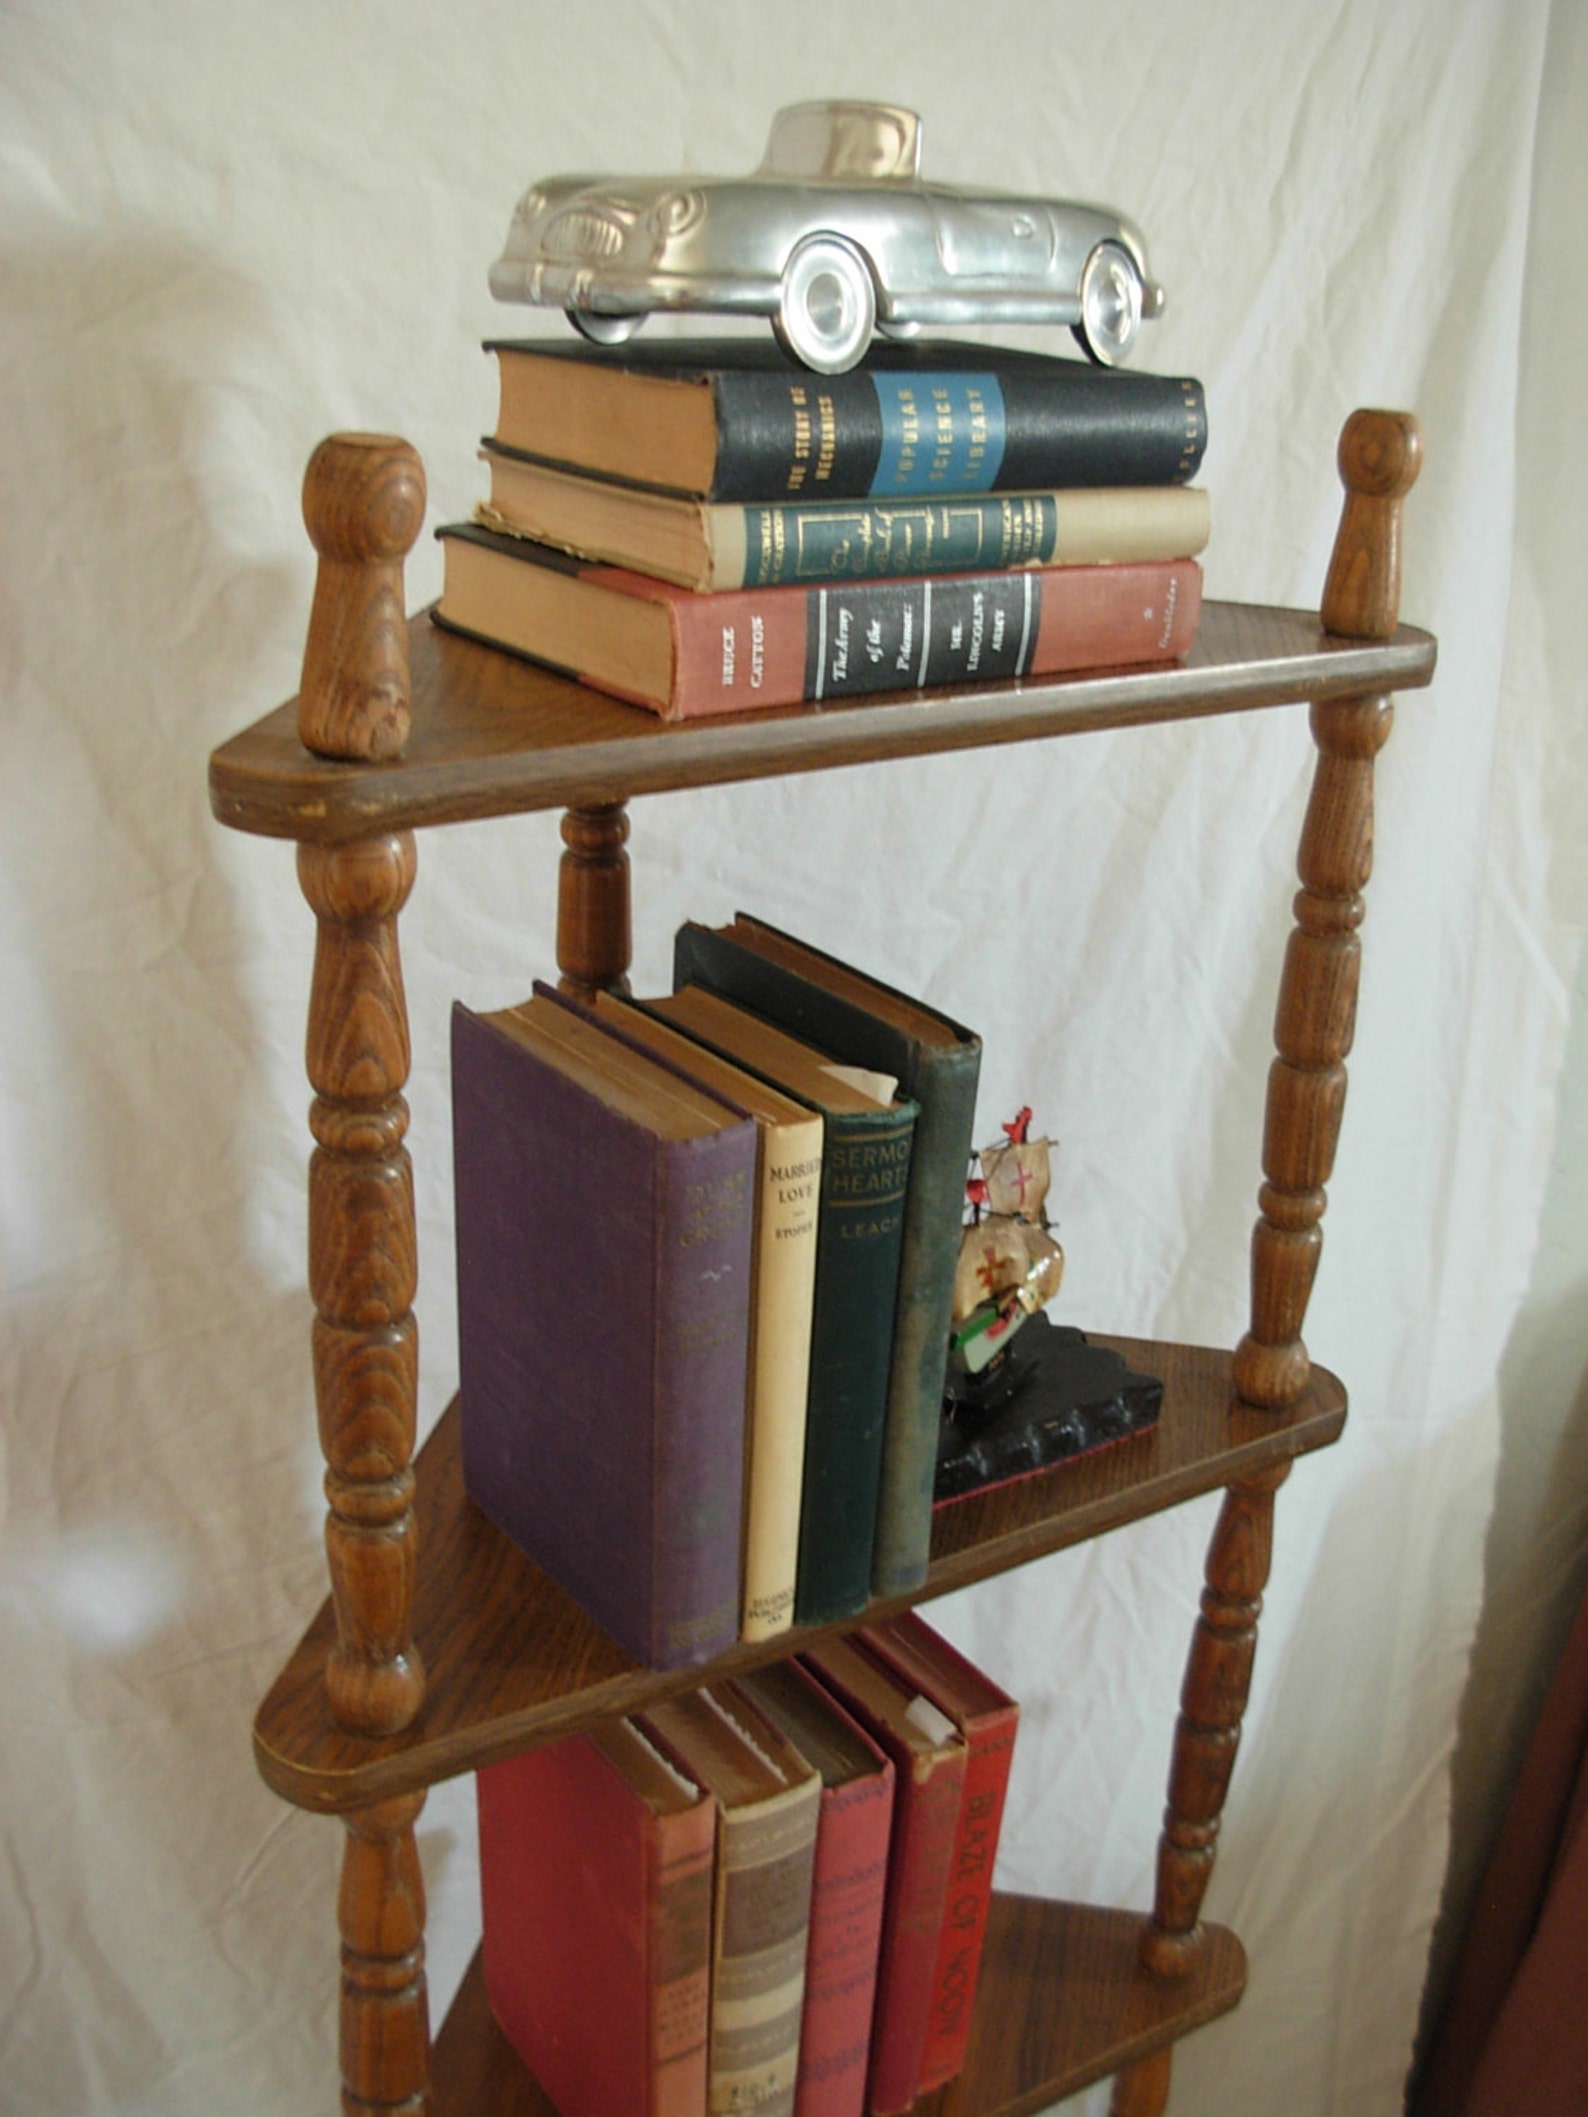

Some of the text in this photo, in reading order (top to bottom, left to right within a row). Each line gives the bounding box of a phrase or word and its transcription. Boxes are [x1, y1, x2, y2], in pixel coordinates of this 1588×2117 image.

[793, 411, 811, 459] STORY
[815, 395, 836, 481] MECHANICS
[894, 388, 918, 483] POPULAR
[928, 387, 954, 481] SCIENCE
[962, 387, 987, 481] LIBRARY
[721, 626, 735, 686] BRUCE
[749, 615, 764, 689] CATTON
[832, 607, 854, 682] The Army
[866, 618, 885, 663] of the
[966, 591, 984, 672] LINCOLN'S
[991, 608, 1006, 652] ARMY
[778, 1185, 814, 1204] LOVE
[957, 1789, 998, 1882] BLAZE
[950, 1895, 980, 1932] OF
[937, 1946, 974, 2037] NOON
